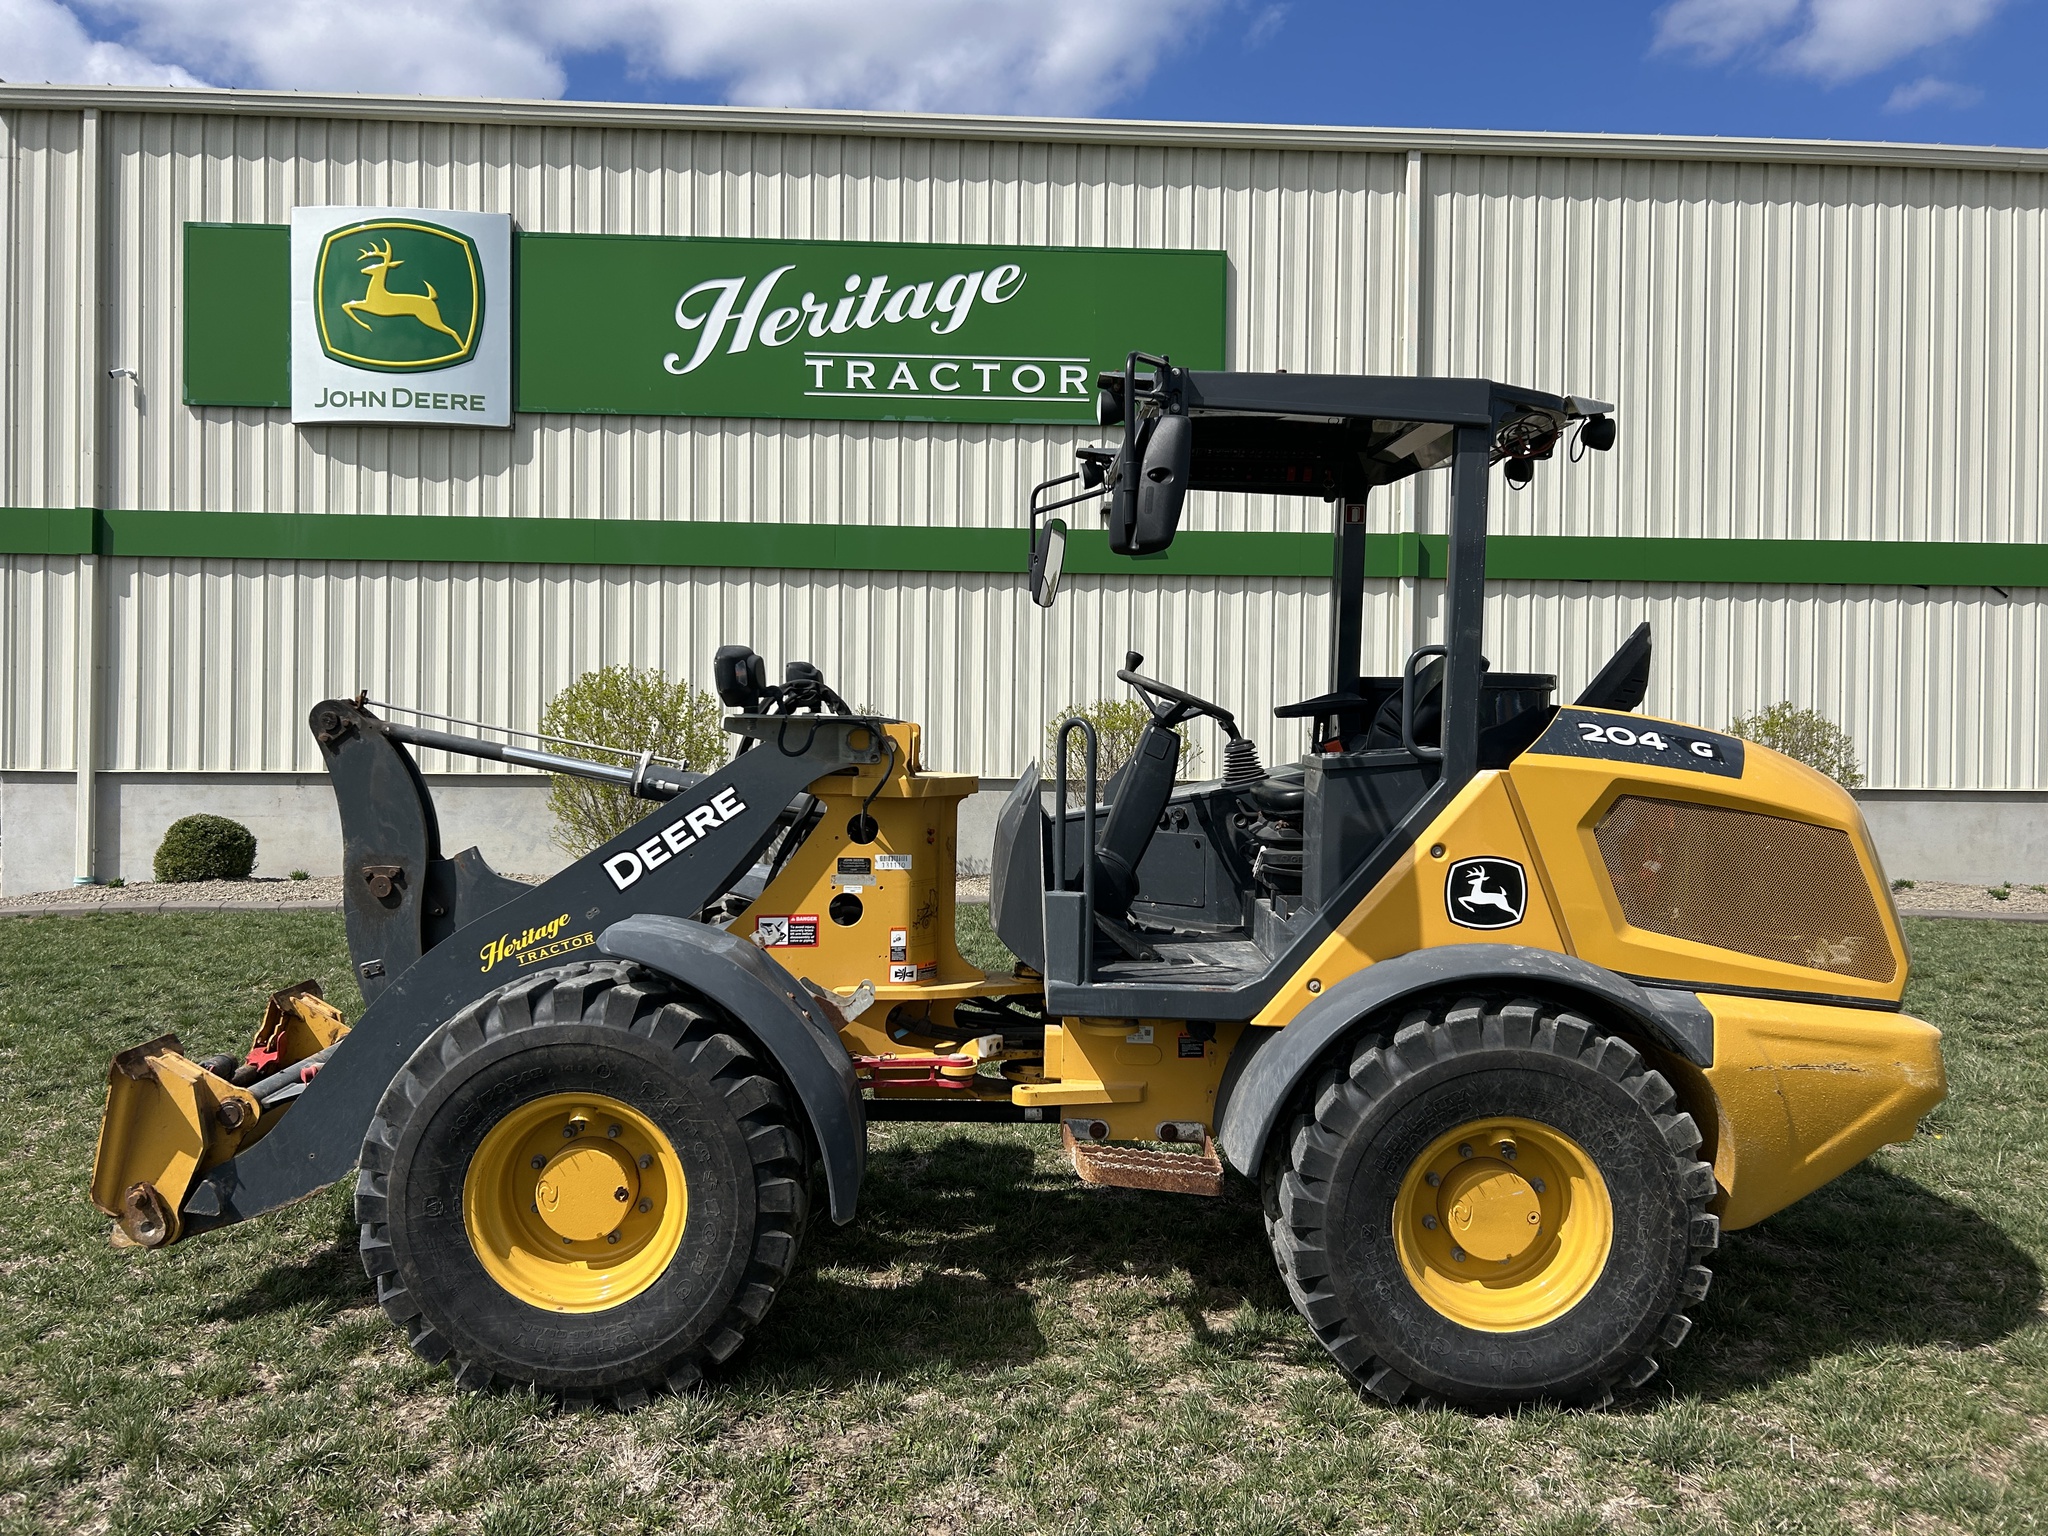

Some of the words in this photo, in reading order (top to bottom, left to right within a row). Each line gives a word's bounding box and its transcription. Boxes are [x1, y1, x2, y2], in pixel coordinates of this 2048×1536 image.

[662, 263, 1028, 376] Heritage
[804, 358, 1089, 395] TRACTOR
[314, 387, 387, 409] JOHN
[392, 387, 485, 412] DEERE
[1577, 722, 1669, 751] 204
[1690, 741, 1714, 759] G
[602, 786, 747, 891] DEERE
[479, 913, 571, 973] Heritage
[516, 933, 596, 965] TRACTOR
